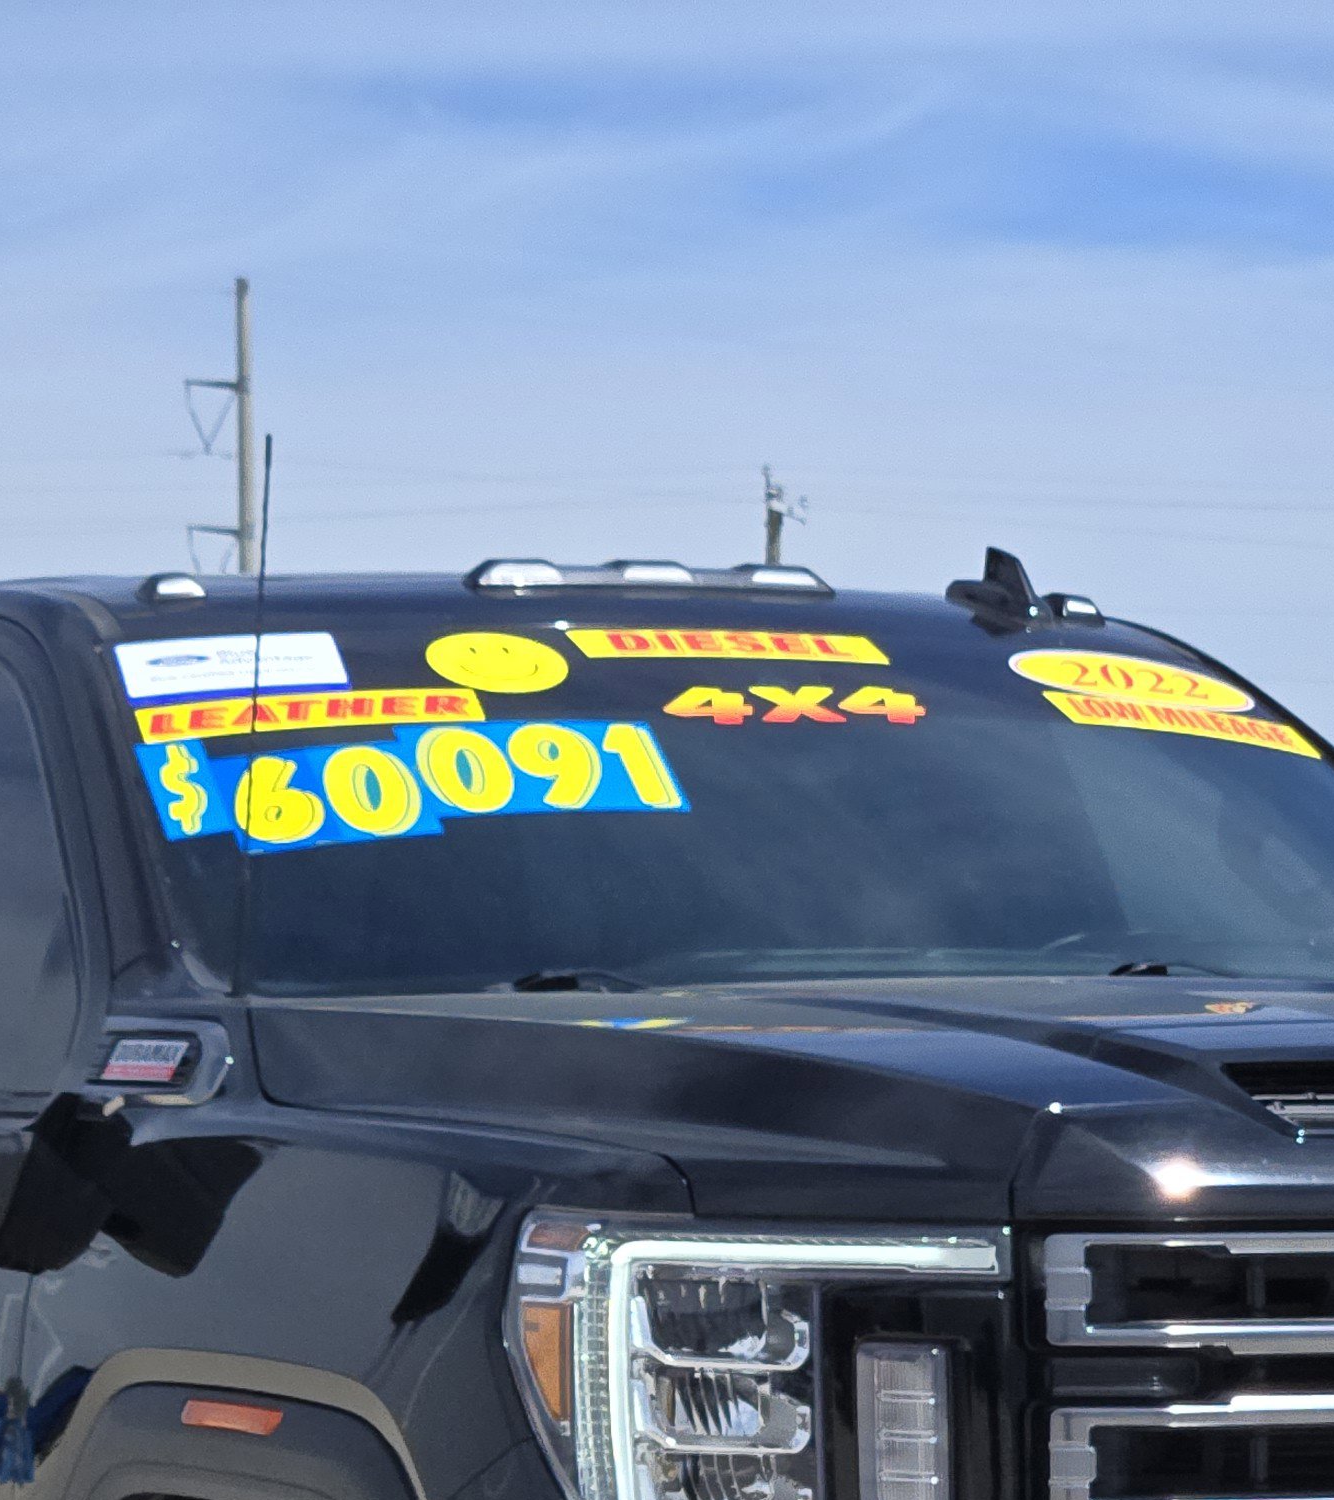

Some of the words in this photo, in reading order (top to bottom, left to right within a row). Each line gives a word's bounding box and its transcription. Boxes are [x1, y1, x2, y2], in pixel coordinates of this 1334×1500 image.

[606, 632, 855, 657] DIESEL
[1060, 660, 1210, 700] 2022
[149, 695, 471, 737] LEATHER
[1066, 695, 1147, 722] LOW
[1147, 704, 1296, 747] MILEAGE
